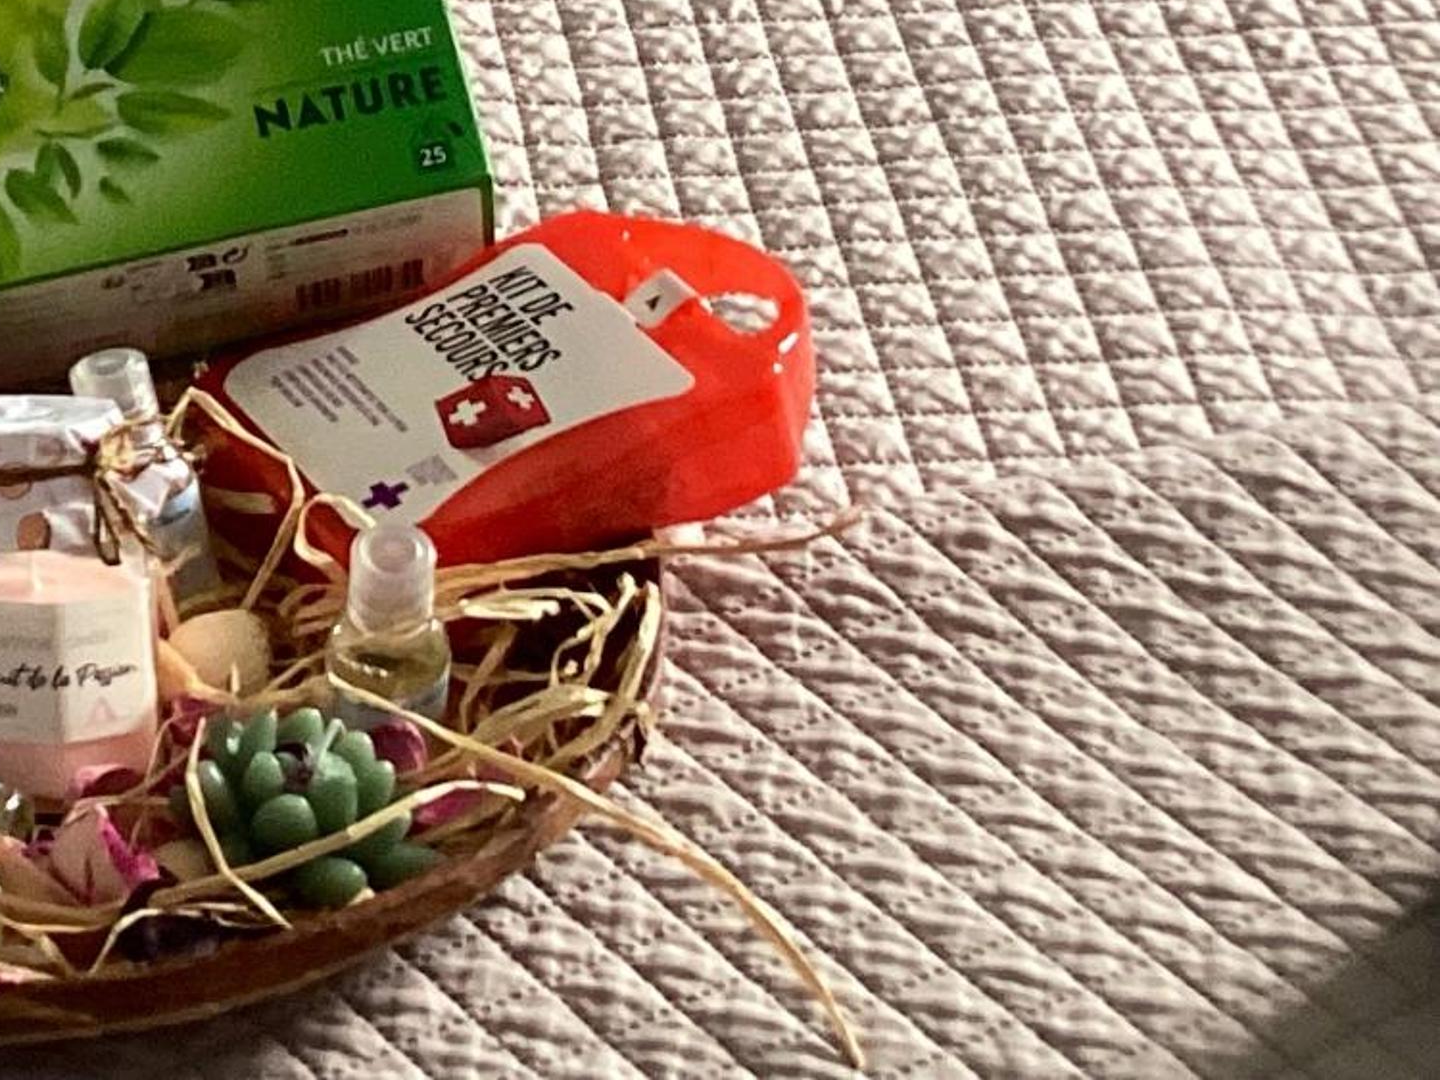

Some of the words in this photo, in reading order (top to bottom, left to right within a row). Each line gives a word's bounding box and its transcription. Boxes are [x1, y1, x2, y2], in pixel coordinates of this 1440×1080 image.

[320, 35, 369, 66] THÉ
[372, 26, 433, 56] VERT
[252, 65, 448, 139] NATURE
[419, 145, 447, 167] 25
[446, 283, 562, 372] PREMIERS
[487, 265, 549, 307] KIT
[519, 289, 574, 326] DE
[404, 302, 510, 383] SECOURS
